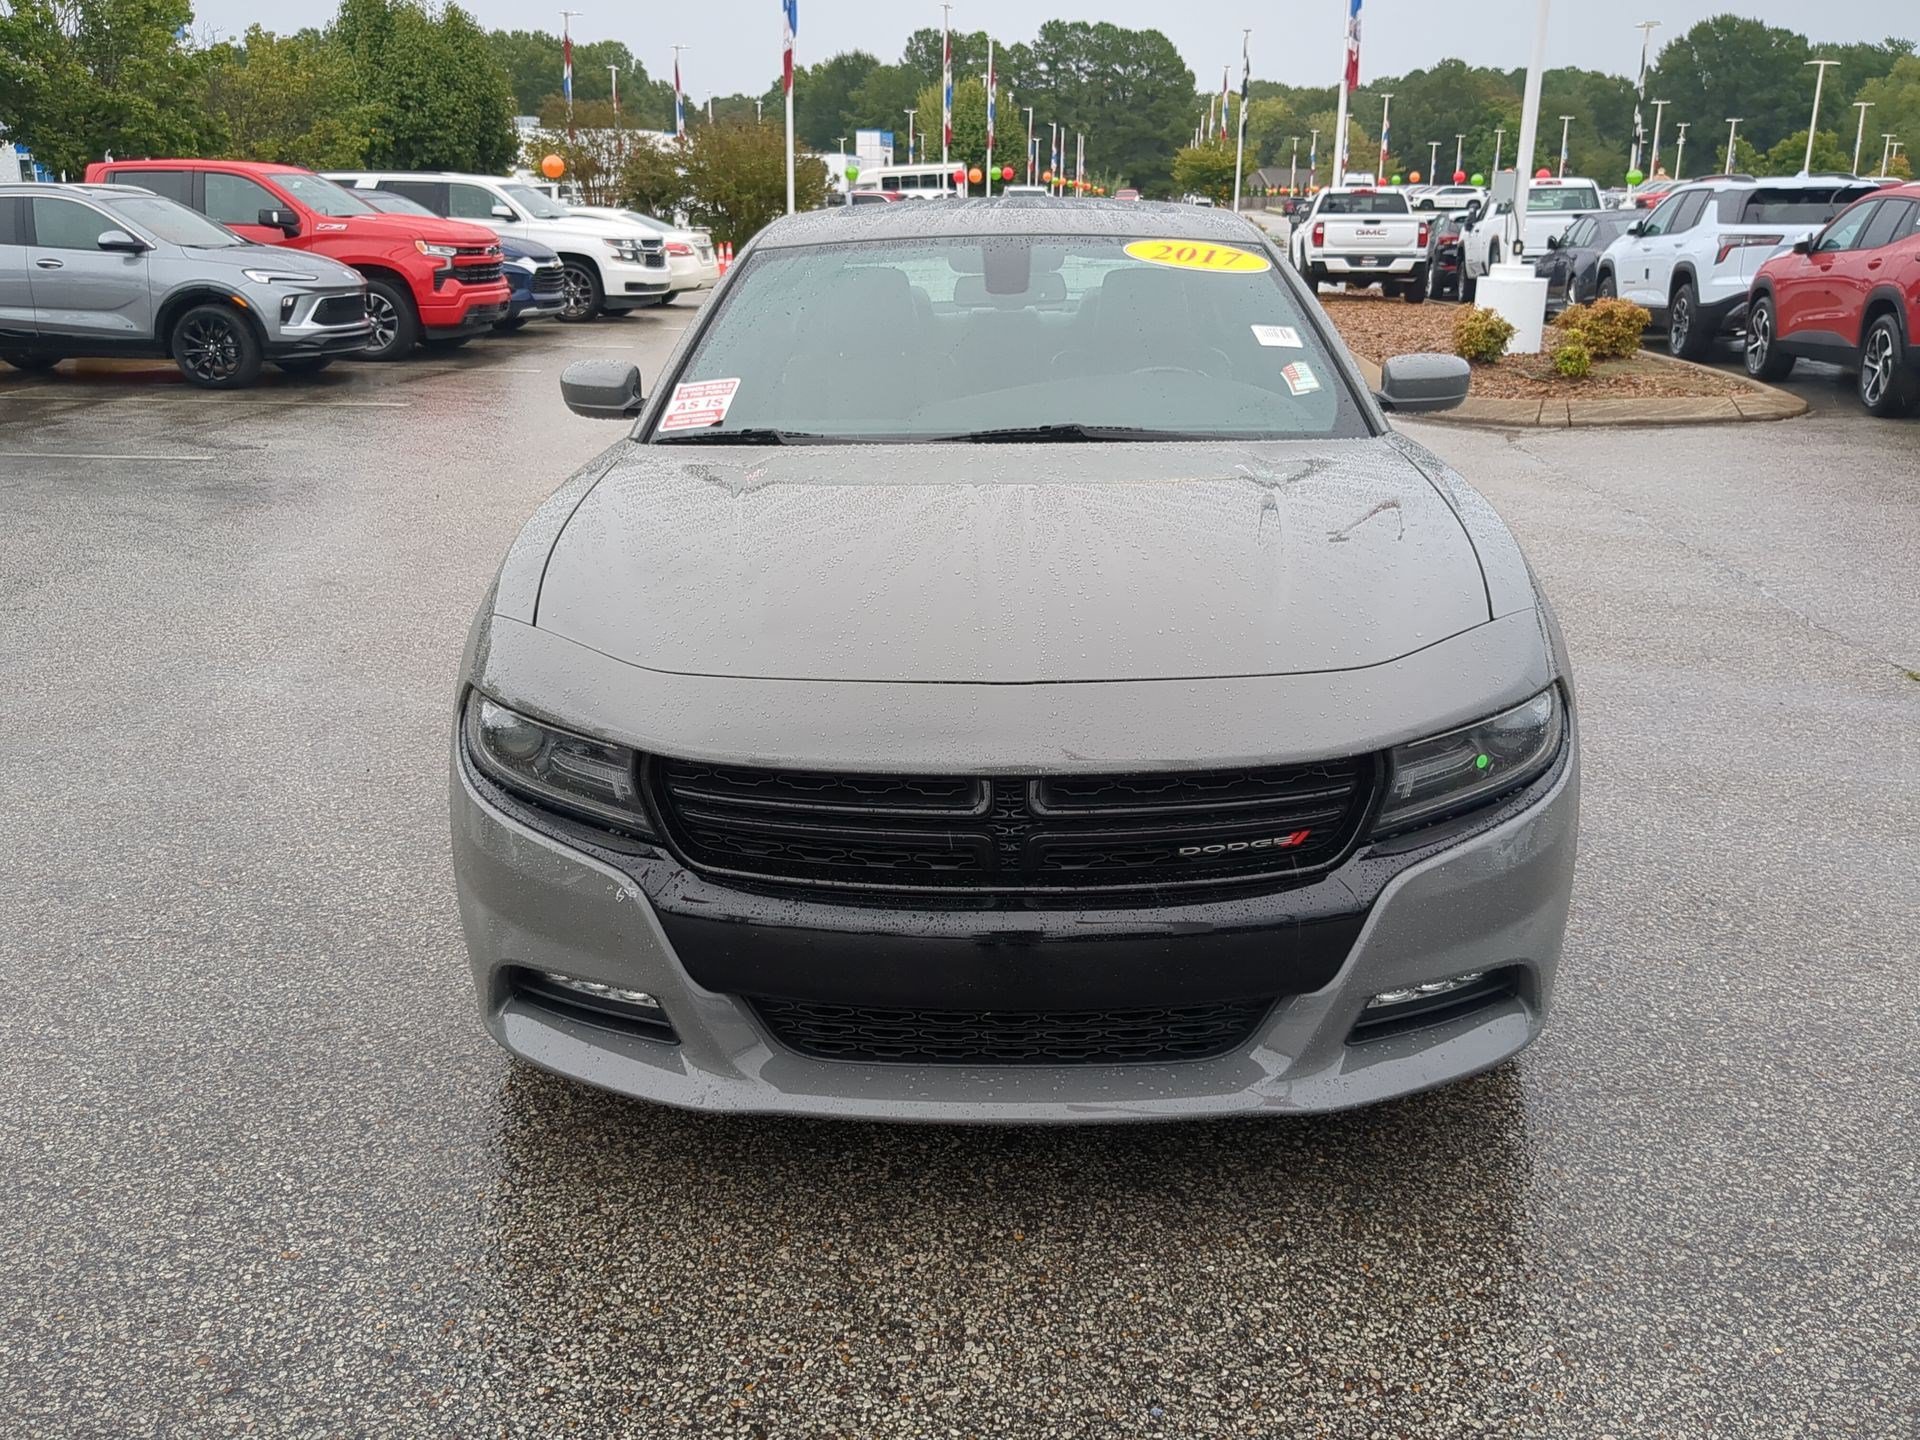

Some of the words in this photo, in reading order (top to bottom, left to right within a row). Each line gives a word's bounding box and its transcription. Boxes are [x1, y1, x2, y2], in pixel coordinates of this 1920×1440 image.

[1151, 244, 1243, 266] 2017
[675, 400, 700, 411] AS
[706, 397, 724, 407] IS
[1179, 835, 1293, 856] DODGE
